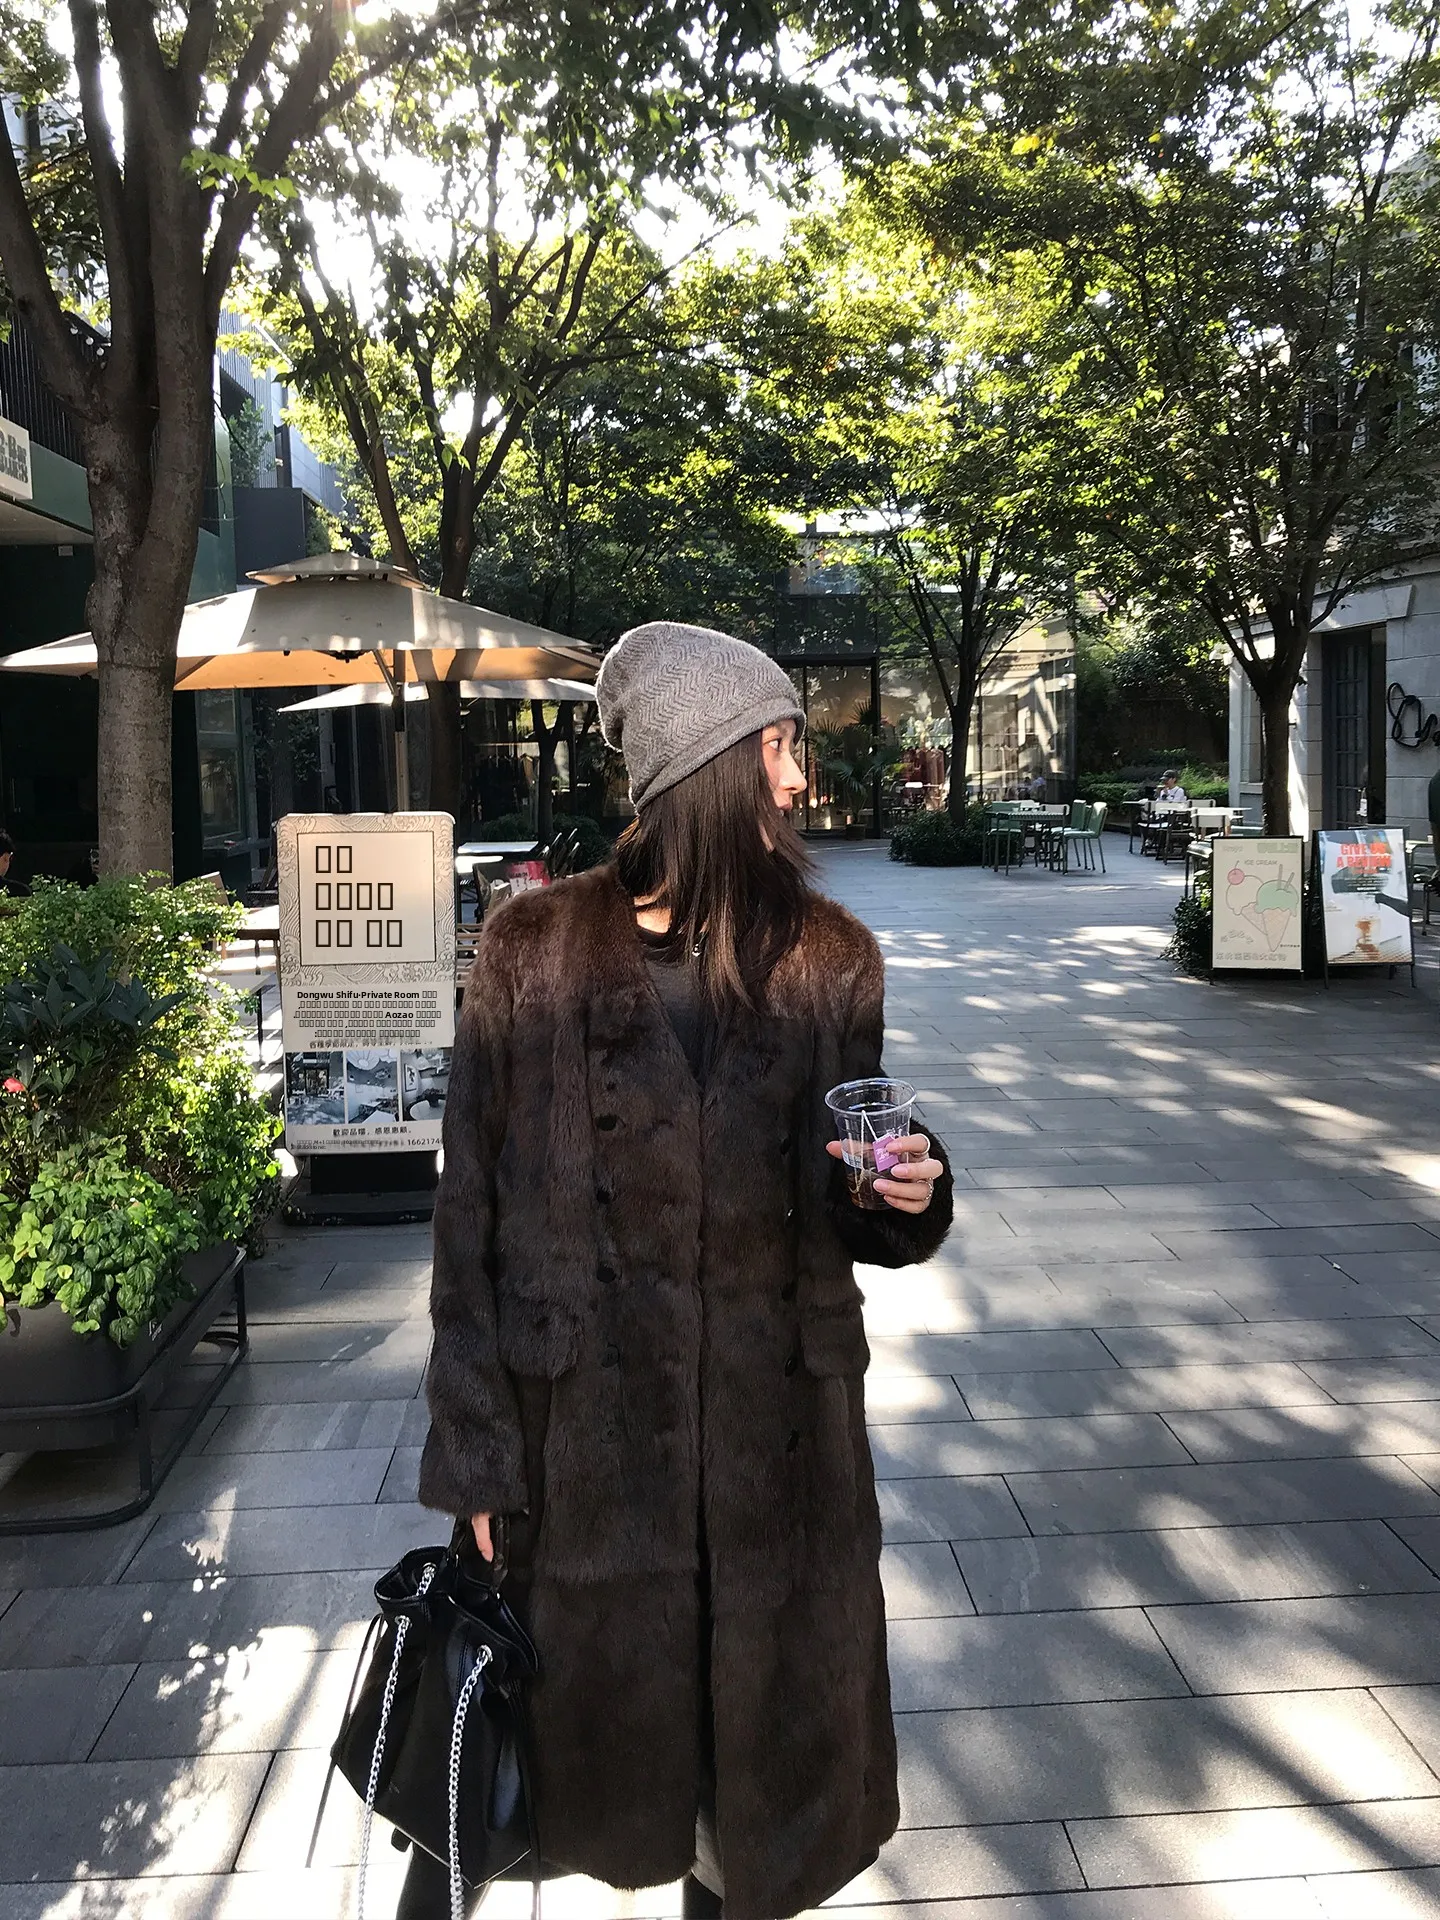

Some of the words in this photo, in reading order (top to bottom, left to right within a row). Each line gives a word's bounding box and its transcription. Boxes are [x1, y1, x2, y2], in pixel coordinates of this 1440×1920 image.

[1340, 844, 1367, 855] GIVE
[1336, 856, 1345, 868] A
[1347, 855, 1392, 867] REVIEW
[297, 991, 333, 1000] Dongwu
[395, 991, 420, 999] Room
[385, 1011, 414, 1019] Aozao
[407, 1138, 443, 1146] 1662174
